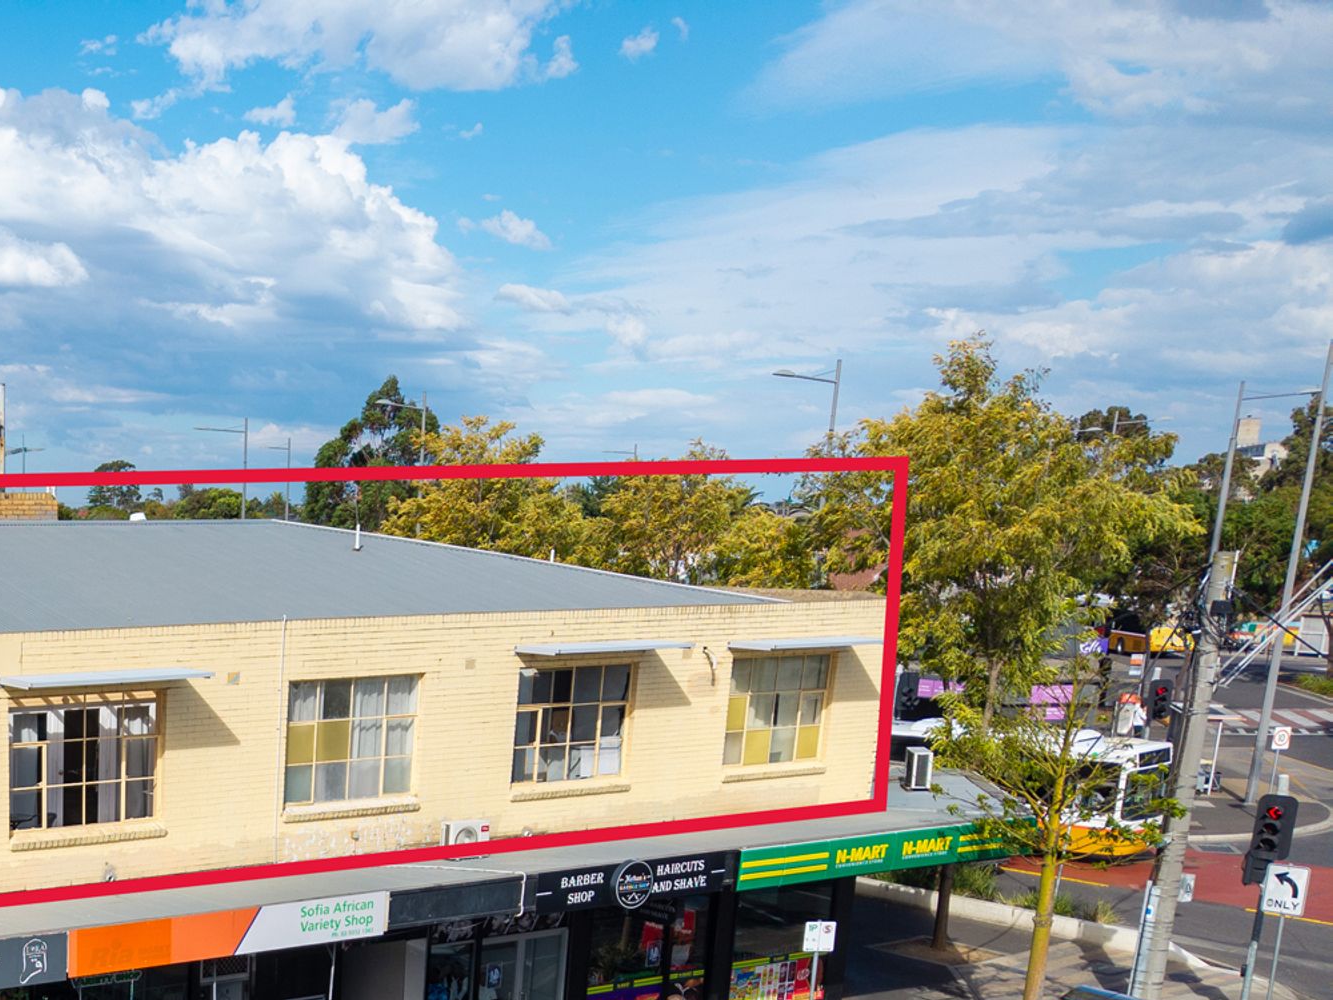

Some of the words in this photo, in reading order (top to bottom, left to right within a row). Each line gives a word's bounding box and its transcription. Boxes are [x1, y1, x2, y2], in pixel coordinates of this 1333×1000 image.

[835, 844, 889, 864] N-MART
[902, 836, 954, 857] N-MART
[656, 860, 705, 876] HAIRCUTS
[561, 872, 604, 889] BARBER
[652, 880, 672, 893] AND
[673, 875, 707, 891] SHAVE
[567, 891, 596, 905] SHOP
[1266, 898, 1299, 911] ONLY
[300, 904, 330, 918] Sofia
[333, 900, 374, 914] African
[300, 917, 341, 932] Variety
[344, 914, 373, 927] Shop
